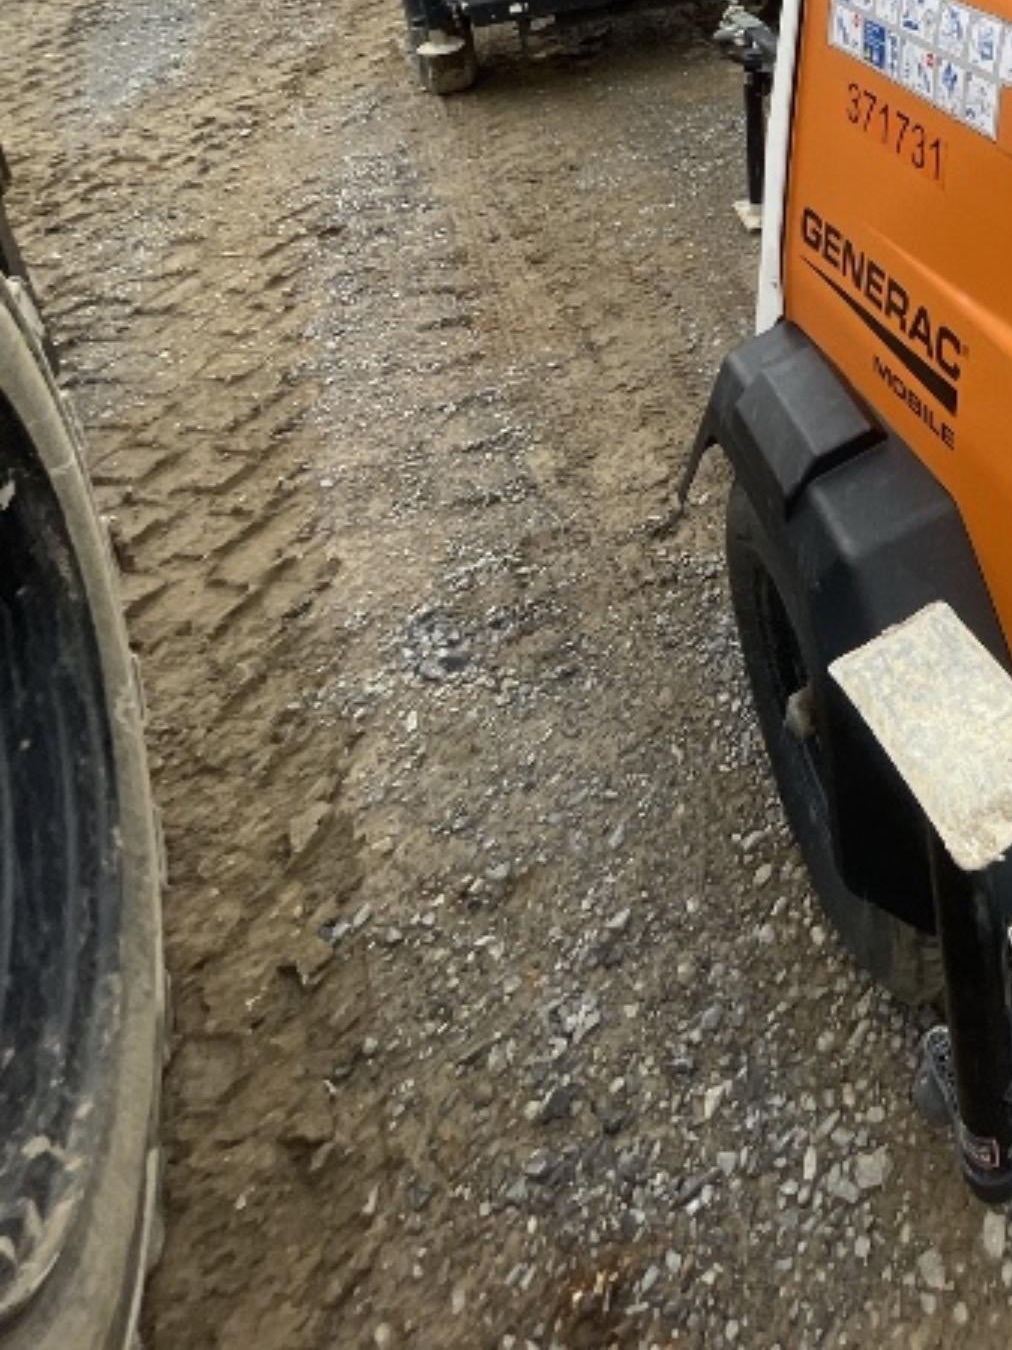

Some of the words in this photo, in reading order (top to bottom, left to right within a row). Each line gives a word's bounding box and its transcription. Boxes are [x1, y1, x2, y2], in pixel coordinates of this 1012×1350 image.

[847, 82, 941, 181] 371731
[801, 206, 962, 382] GENERAC
[873, 355, 955, 451] MOBILE
